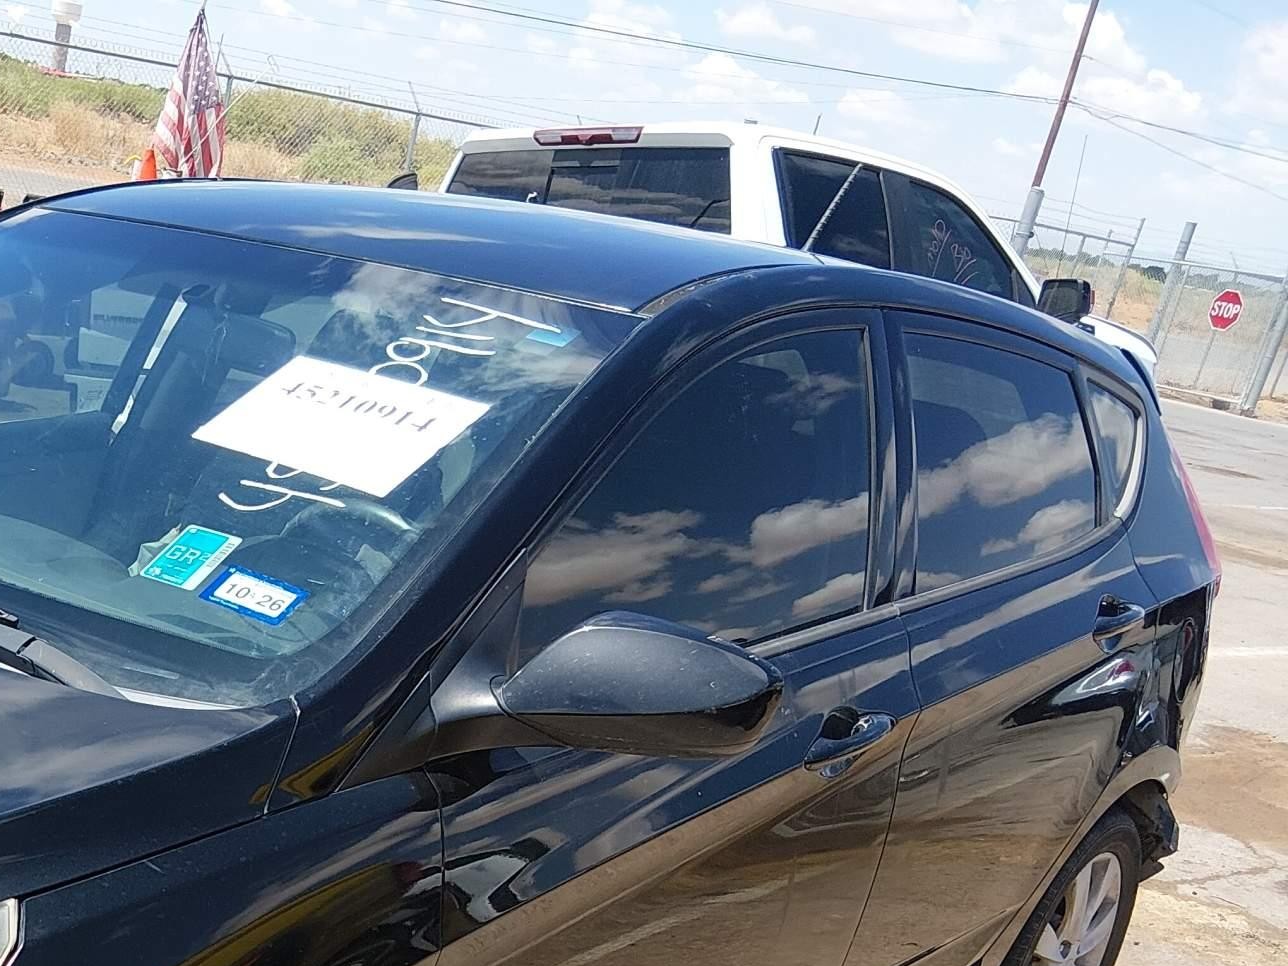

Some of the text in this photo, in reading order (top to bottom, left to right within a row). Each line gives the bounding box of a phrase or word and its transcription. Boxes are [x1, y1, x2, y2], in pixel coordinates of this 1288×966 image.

[1211, 301, 1241, 319] STOP
[282, 381, 437, 432] 45210914
[256, 594, 286, 612] 26
